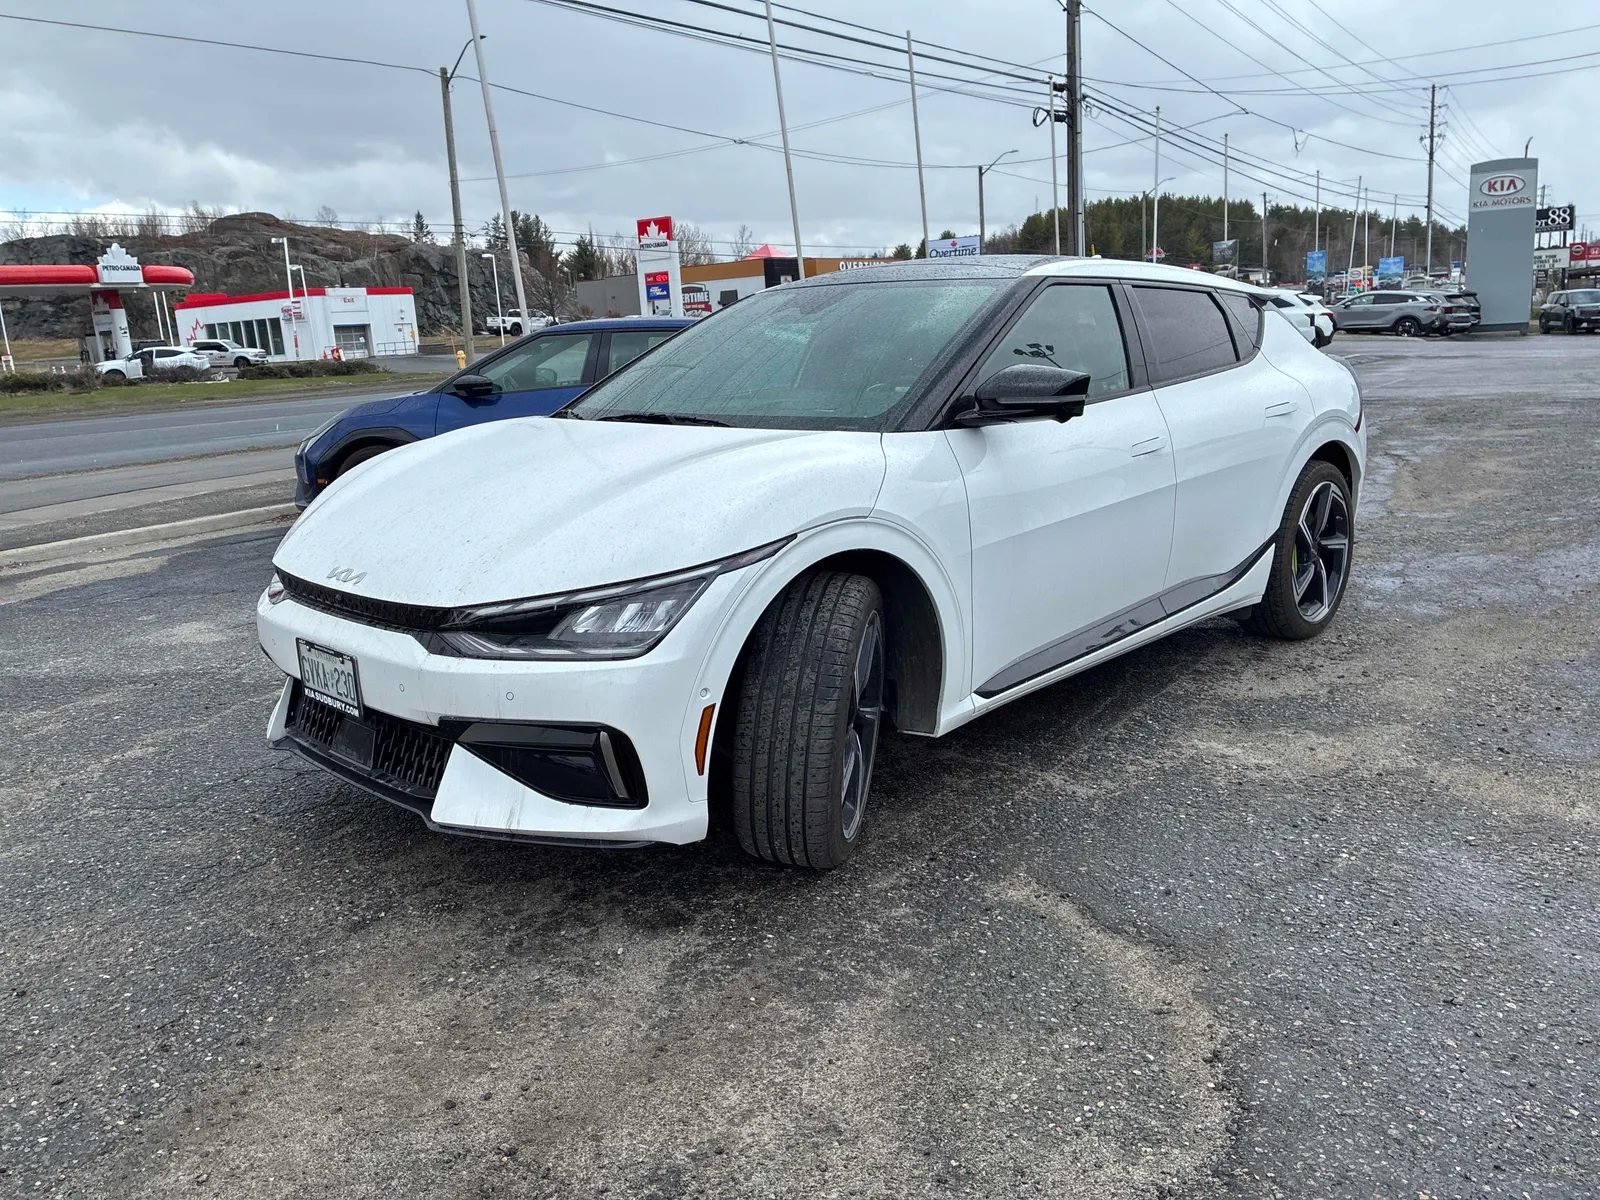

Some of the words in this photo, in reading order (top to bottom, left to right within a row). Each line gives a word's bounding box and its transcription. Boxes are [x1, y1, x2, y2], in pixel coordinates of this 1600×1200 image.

[1487, 179, 1517, 193] KIA
[1473, 200, 1488, 208] KIA
[1491, 195, 1532, 206] MOTORS
[929, 247, 976, 258] Overtime
[839, 261, 885, 271] OVERTI
[682, 292, 709, 303] ERTIME
